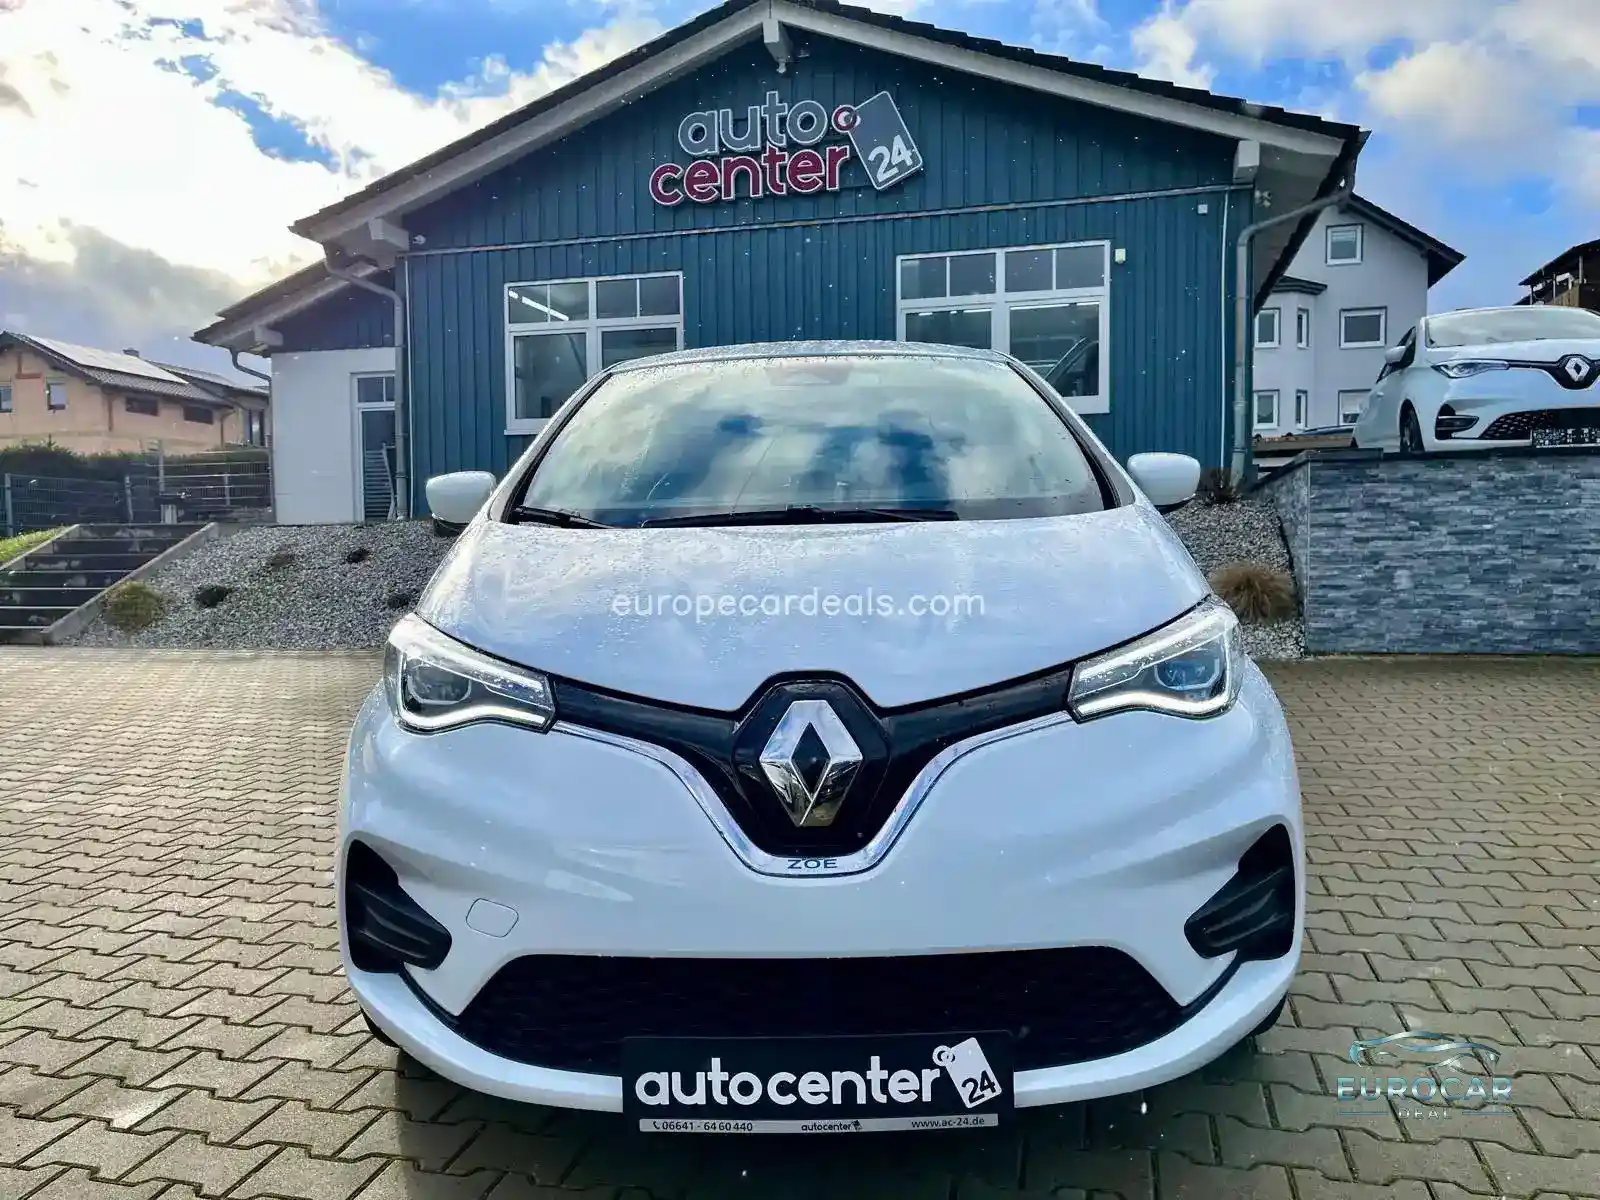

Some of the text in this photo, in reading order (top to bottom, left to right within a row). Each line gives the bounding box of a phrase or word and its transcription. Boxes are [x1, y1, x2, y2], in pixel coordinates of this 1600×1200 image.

[678, 90, 828, 155] auto
[649, 144, 850, 206] center
[867, 134, 913, 182] 24
[787, 858, 838, 870] ZOE
[961, 1070, 997, 1105] 24
[801, 1123, 851, 1132] autocenter
[911, 1116, 985, 1128] www.ac-24.de
